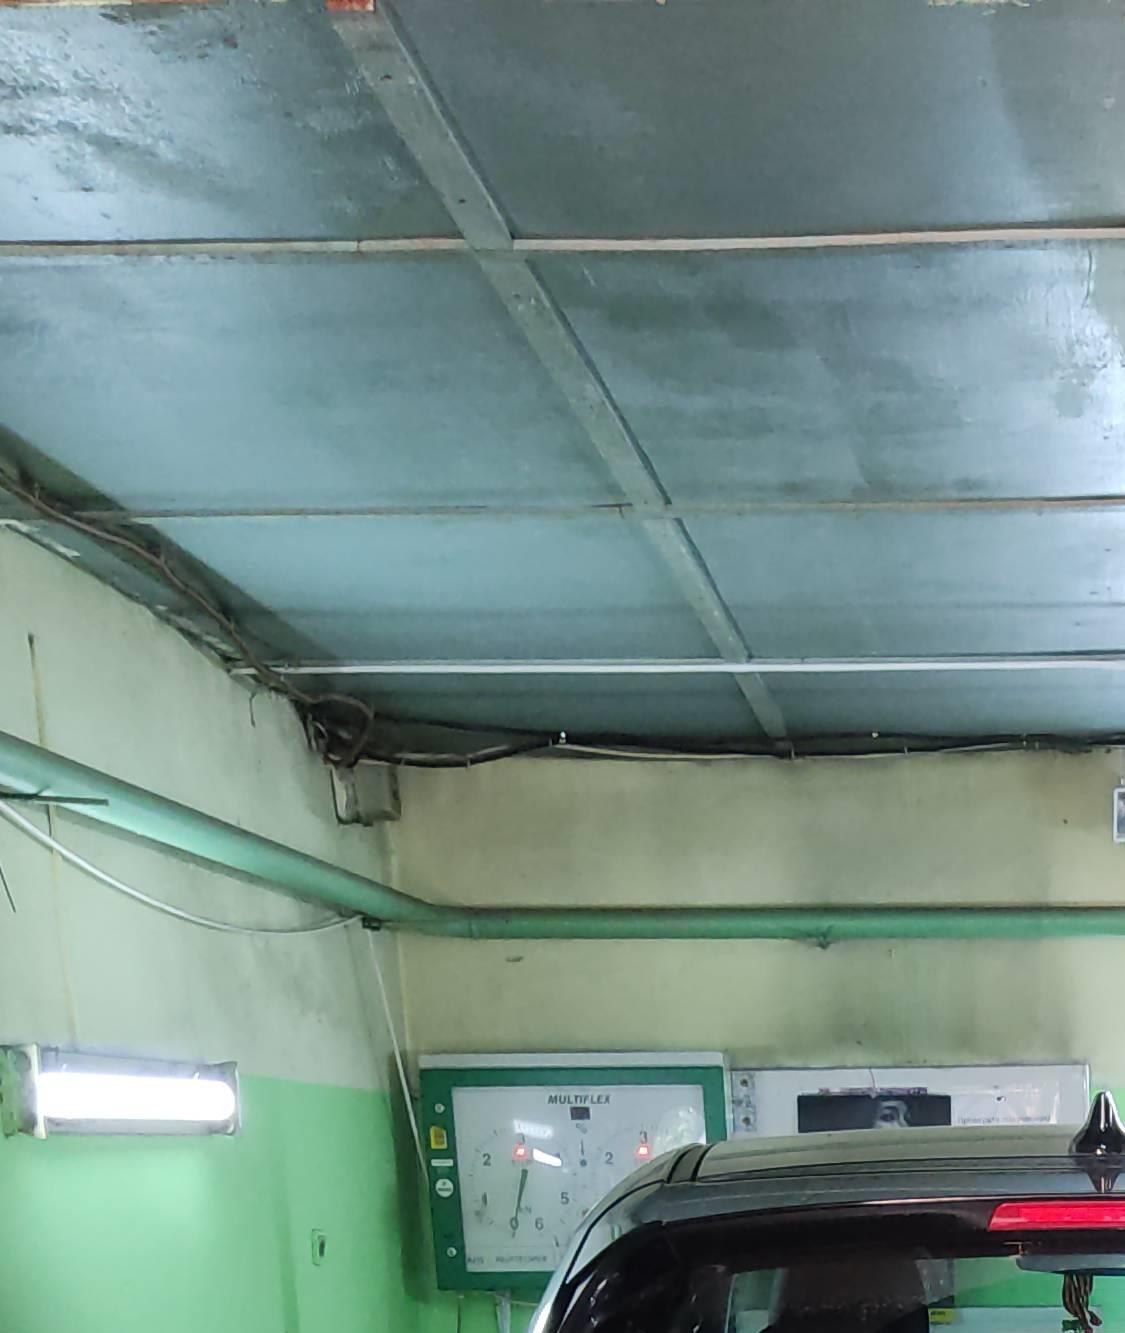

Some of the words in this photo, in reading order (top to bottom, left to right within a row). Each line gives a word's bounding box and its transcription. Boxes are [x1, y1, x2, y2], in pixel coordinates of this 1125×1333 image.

[547, 1094, 611, 1106] MULTIFLEX
[482, 1153, 492, 1167] 2
[604, 1151, 614, 1165] 2
[560, 1191, 570, 1205] 5
[534, 1216, 545, 1231] 6
